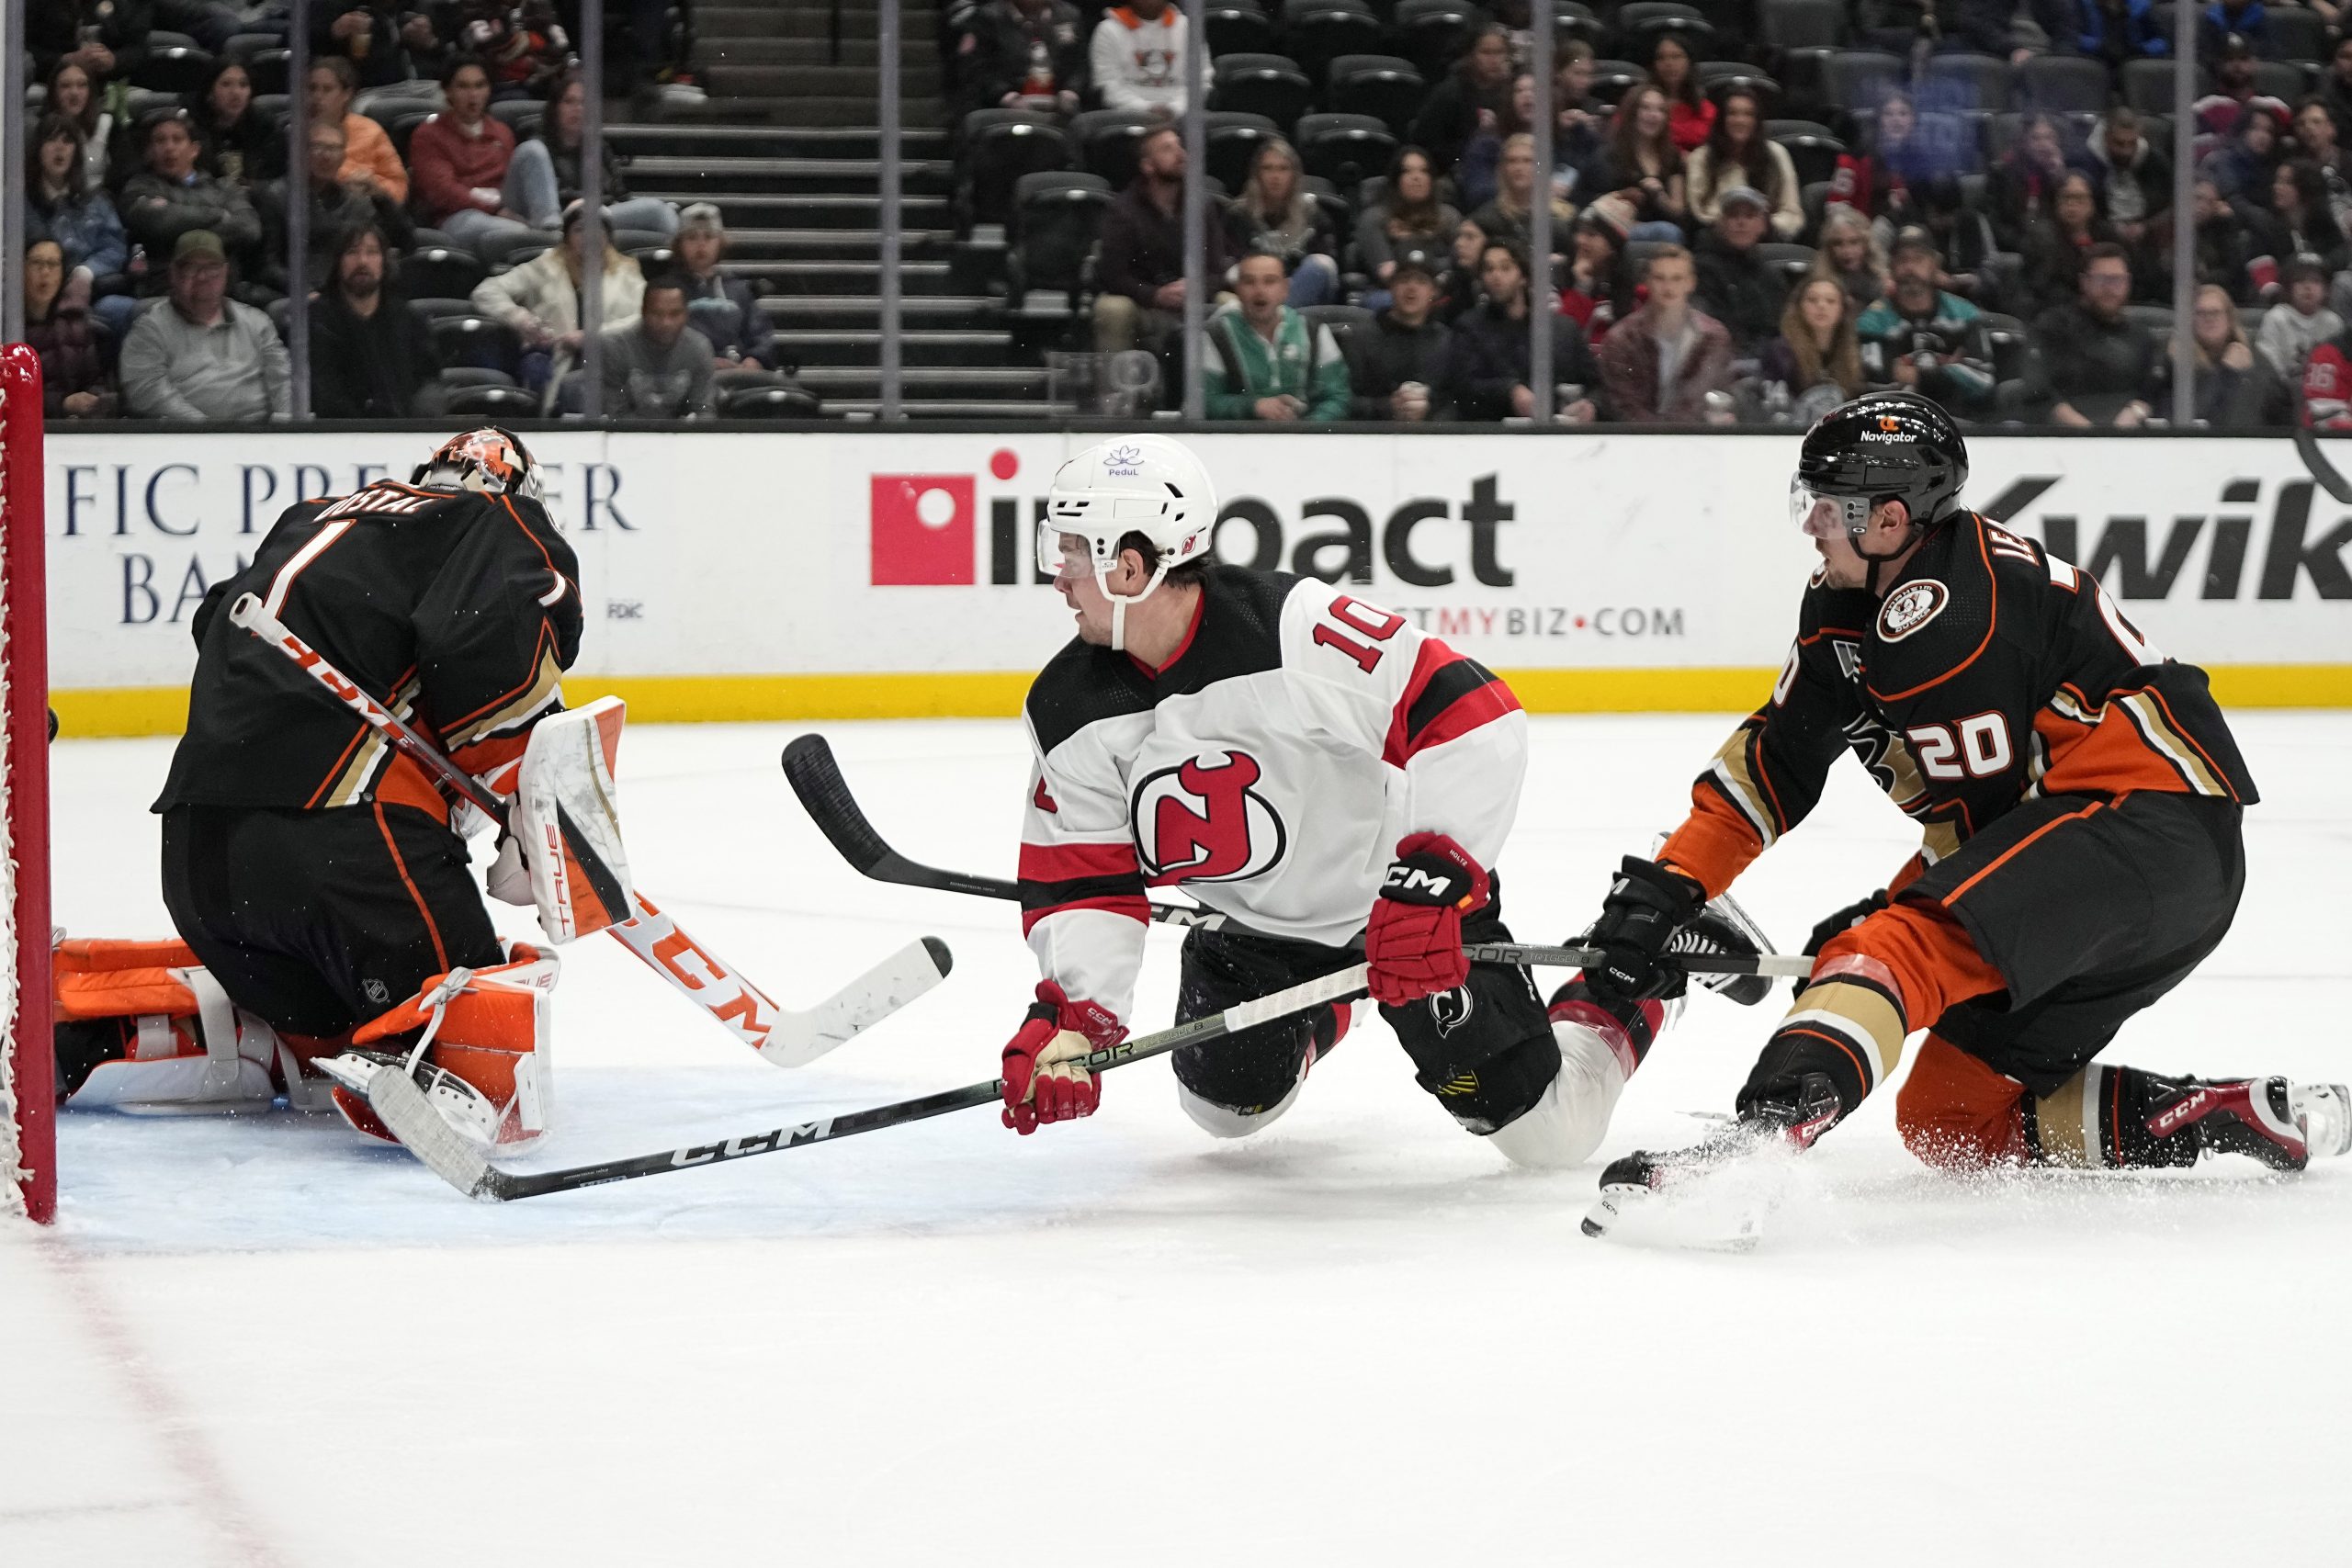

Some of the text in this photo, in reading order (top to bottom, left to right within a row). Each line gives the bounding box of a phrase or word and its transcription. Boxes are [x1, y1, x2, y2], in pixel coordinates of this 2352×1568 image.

[1860, 431, 1917, 444] Navigator
[1109, 468, 1139, 477] PeduL
[1312, 594, 1407, 675] 10
[1906, 709, 2014, 781] 20
[1449, 849, 1468, 867] HOLTZ
[545, 823, 571, 936] TRUE
[1609, 966, 1636, 984] CCM
[1087, 1007, 1113, 1025] CCM
[2159, 1089, 2205, 1128] CCM
[670, 1117, 835, 1167] CCM
